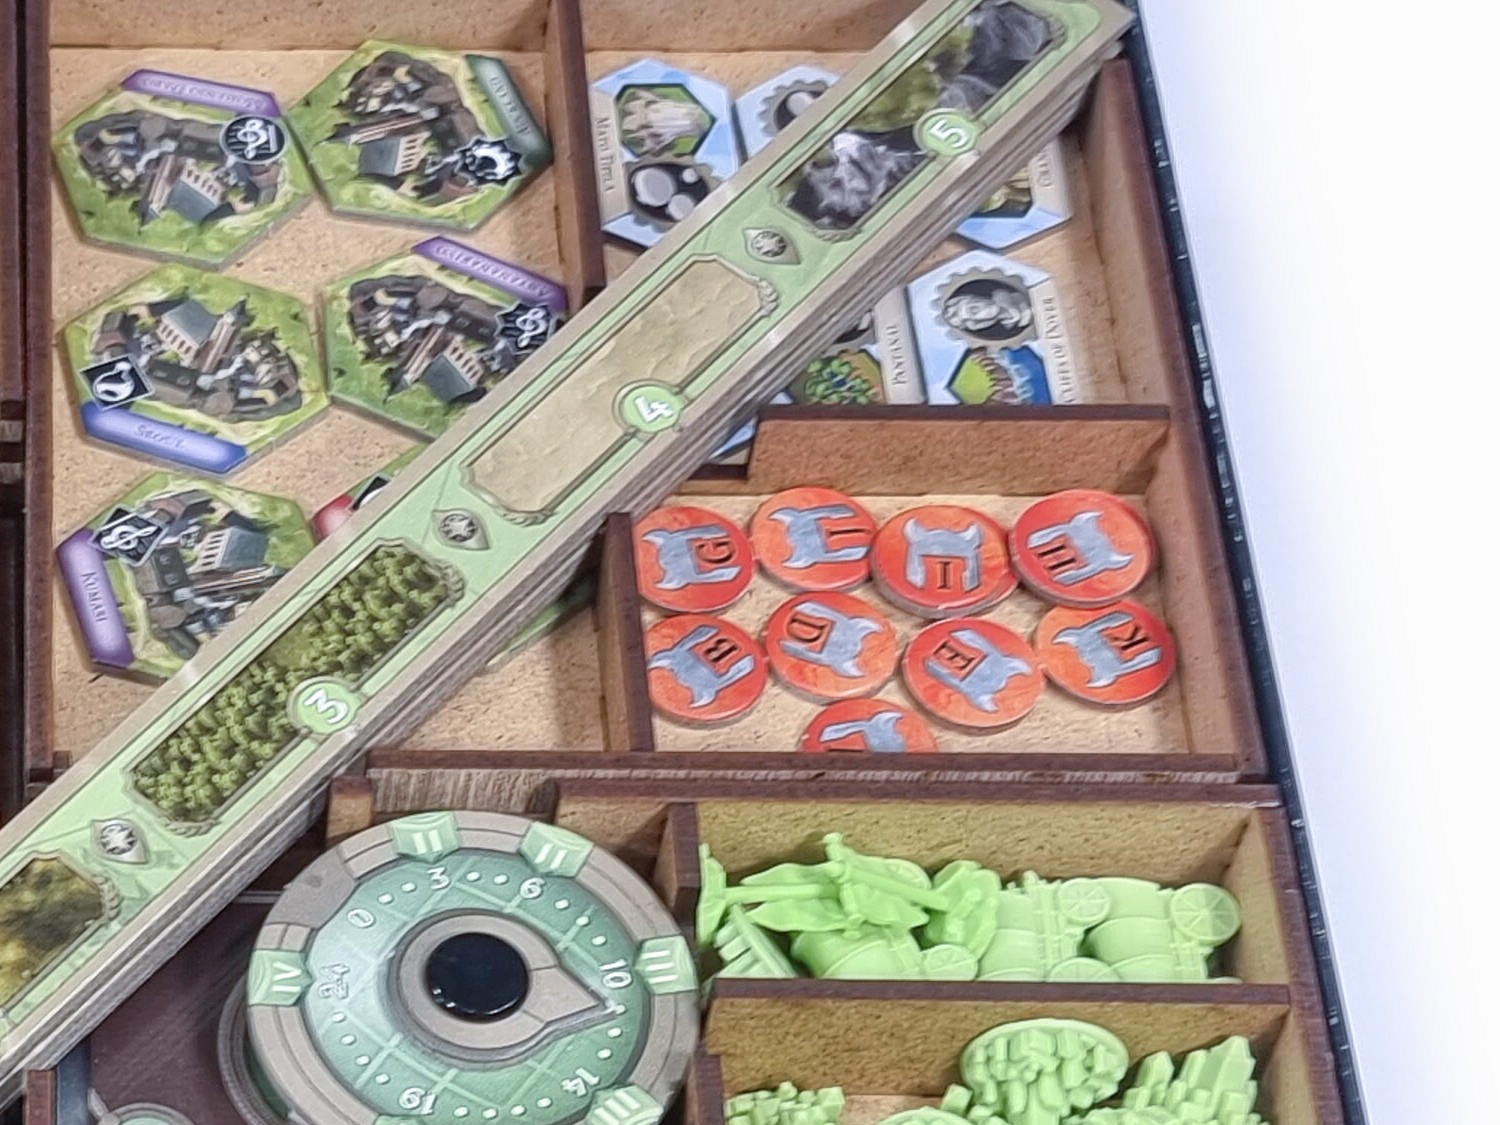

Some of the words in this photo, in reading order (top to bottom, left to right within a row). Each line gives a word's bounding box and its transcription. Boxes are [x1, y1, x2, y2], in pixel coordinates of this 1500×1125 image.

[929, 119, 970, 148] 5
[634, 396, 673, 423] 4
[696, 540, 737, 564] G
[786, 616, 828, 644] D
[1109, 624, 1150, 652] K
[703, 636, 741, 664] B
[932, 640, 975, 671] E
[303, 687, 348, 724] 3
[411, 828, 443, 855] II
[534, 843, 567, 870] II
[426, 866, 451, 890] 3
[519, 876, 547, 899] 6
[347, 908, 376, 929] 0
[272, 960, 303, 994] IV
[599, 958, 633, 989] 10
[643, 949, 679, 984] III
[561, 1066, 600, 1098] 14
[399, 1087, 438, 1115] 19
